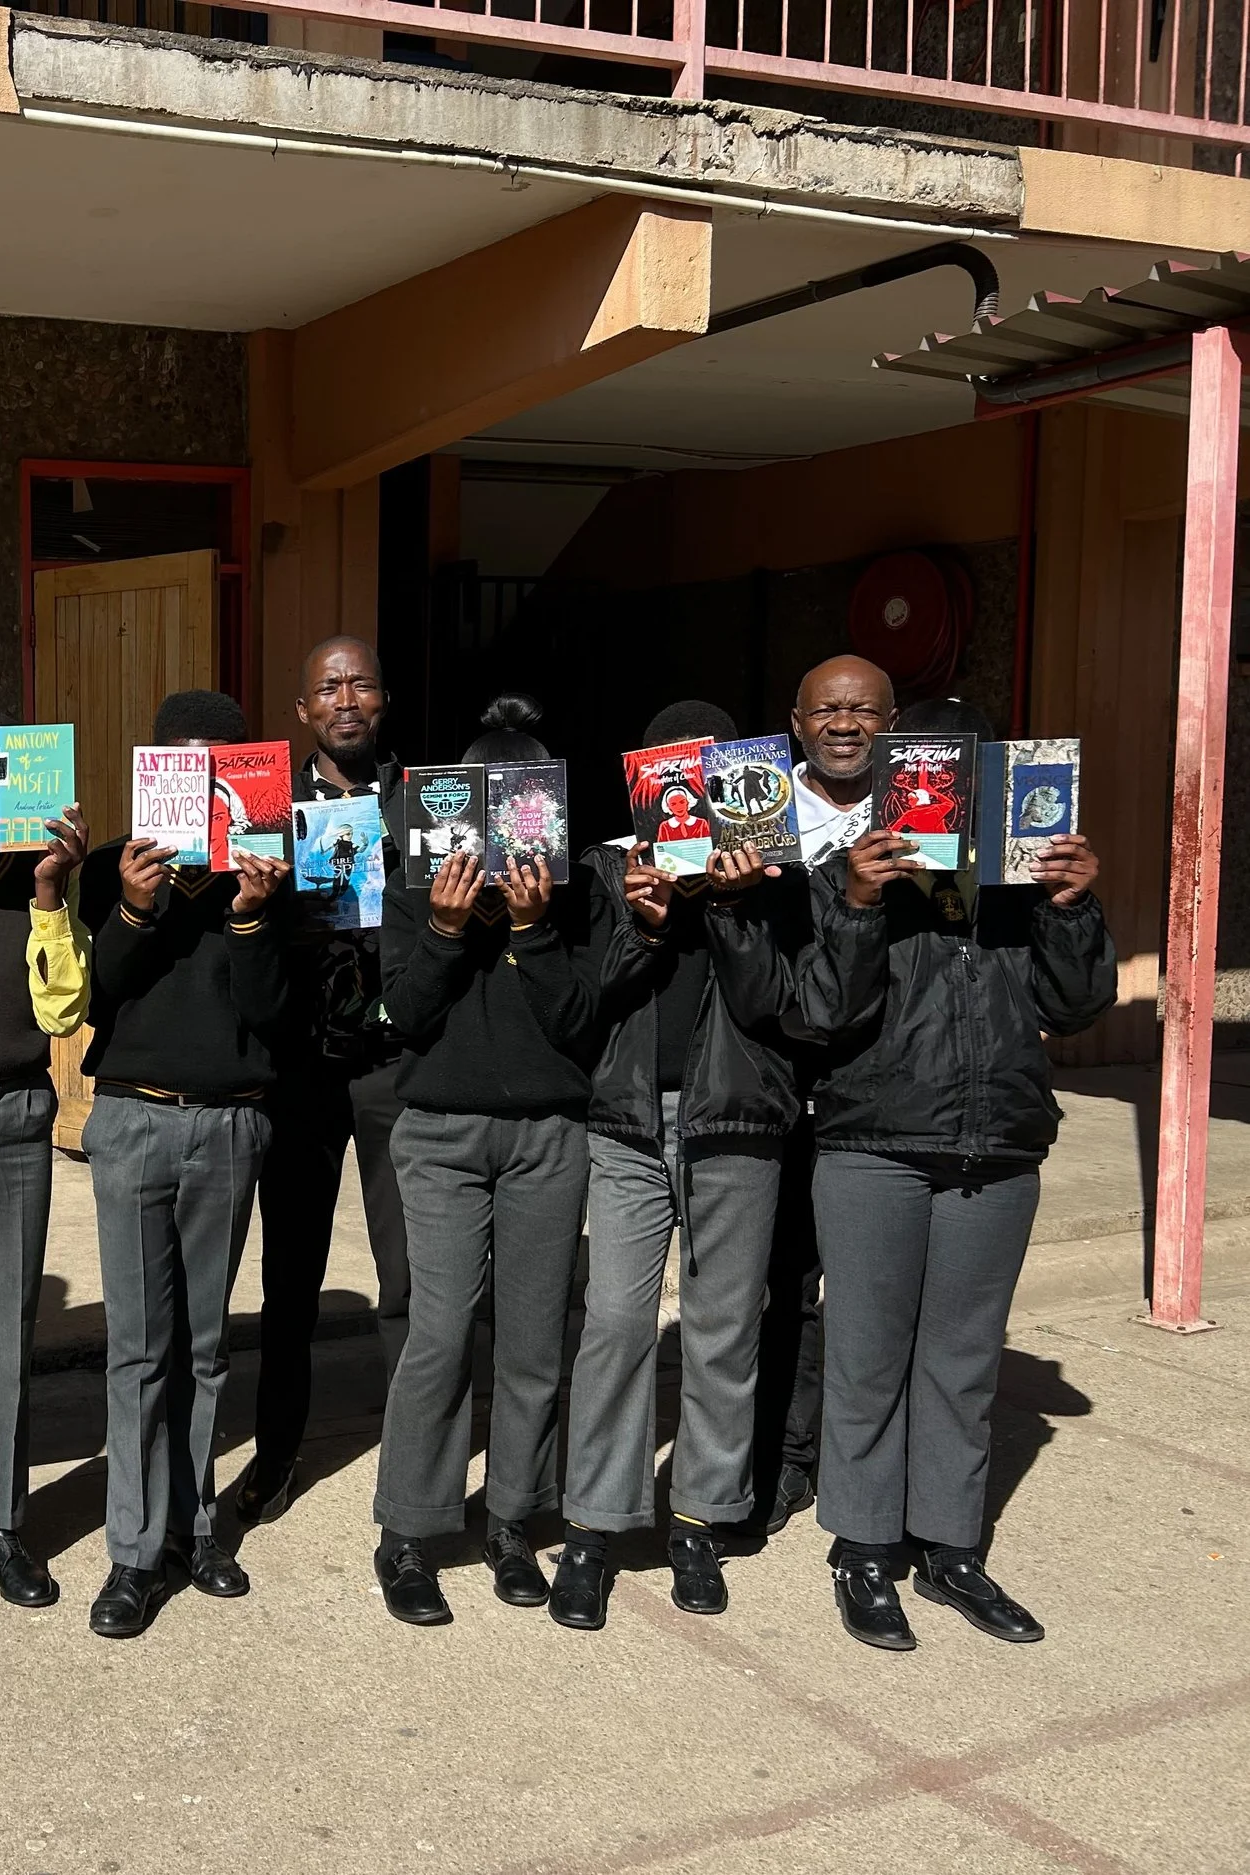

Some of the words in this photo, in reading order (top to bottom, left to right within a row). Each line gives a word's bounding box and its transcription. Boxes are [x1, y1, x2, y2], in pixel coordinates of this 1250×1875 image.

[5, 731, 60, 750] ANATOMY
[710, 747, 746, 760] GARTH
[748, 743, 768, 755] NIX
[768, 742, 777, 751] &
[888, 747, 961, 764] SABRINA
[15, 752, 31, 771] of
[136, 752, 207, 772] ANTHEM
[217, 753, 277, 772] SABRINA
[640, 755, 702, 780] SABRINA
[139, 773, 156, 787] FOR
[155, 772, 206, 795] Jackson
[421, 783, 470, 792] ANDERSON'S
[432, 777, 458, 785] GERRY
[138, 788, 206, 827] Dawes
[719, 815, 788, 843] MYSTERY
[774, 833, 797, 847] CARD
